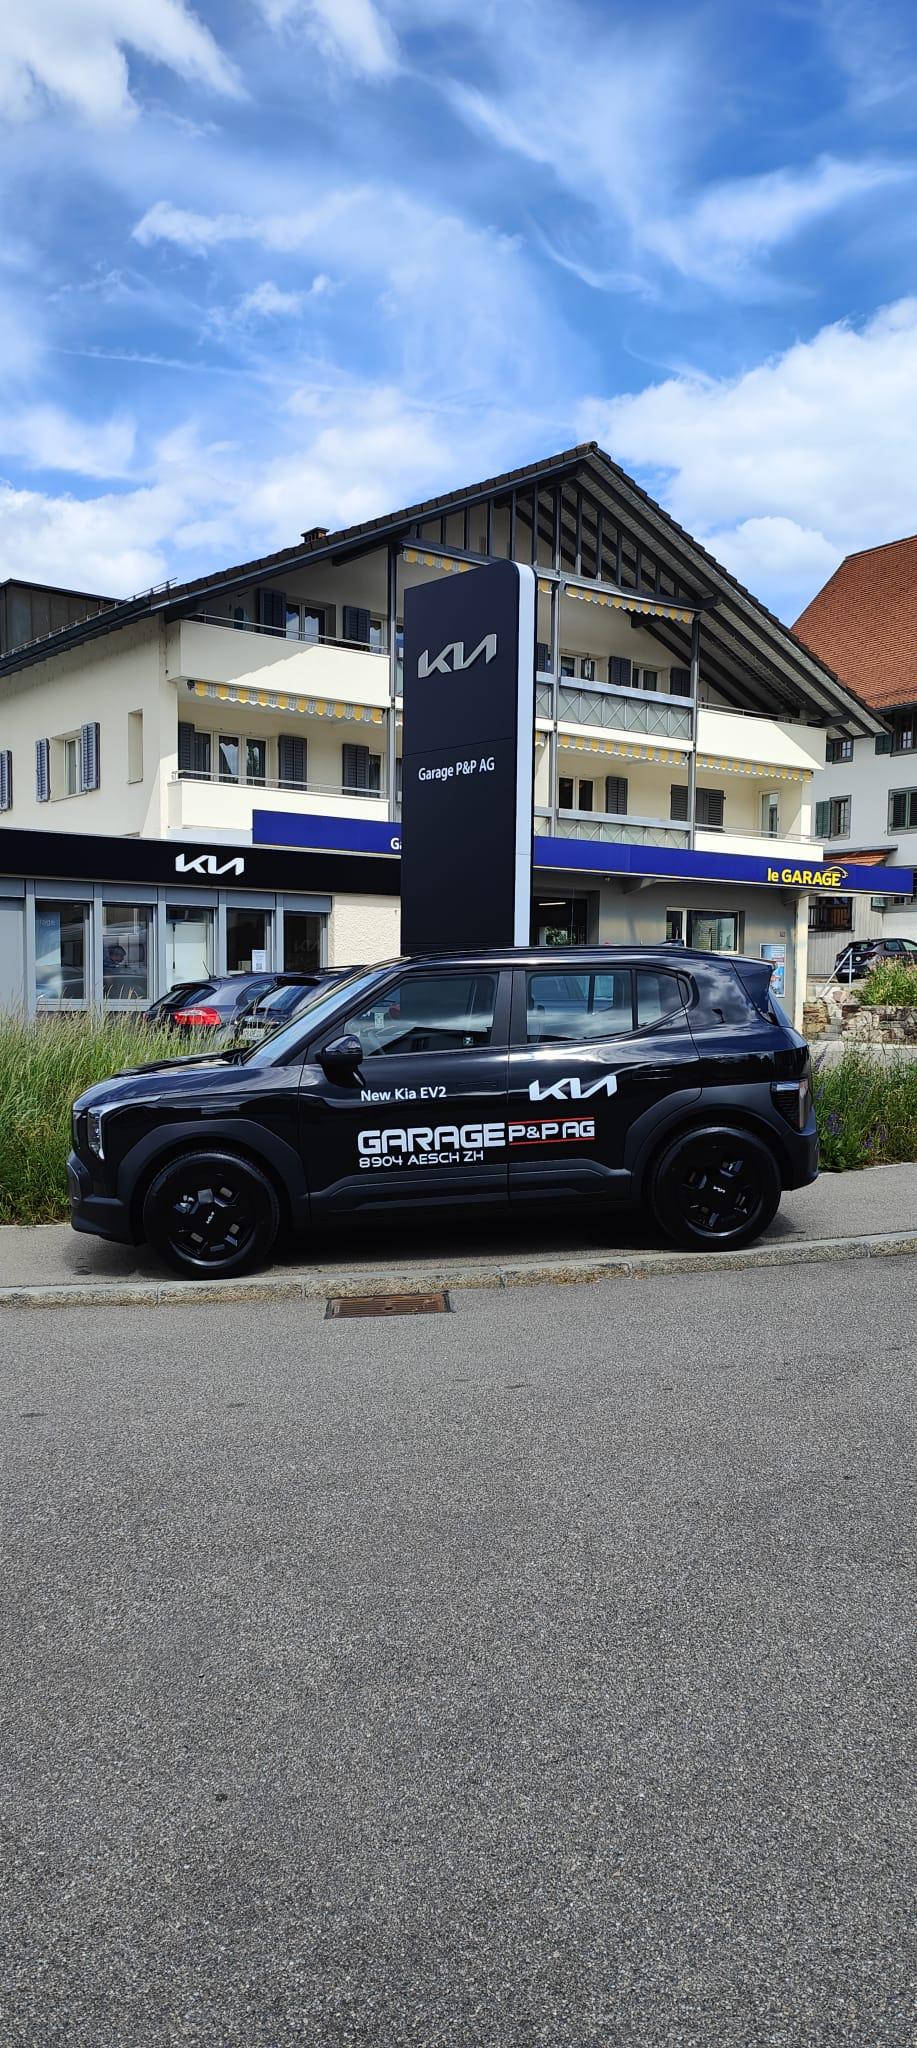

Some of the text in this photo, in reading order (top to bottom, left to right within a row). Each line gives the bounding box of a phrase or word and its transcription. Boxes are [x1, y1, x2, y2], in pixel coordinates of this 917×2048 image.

[417, 633, 498, 679] KIA
[418, 756, 495, 781] Garage P&P AG
[390, 837, 402, 850] G
[175, 853, 245, 876] KIA
[767, 867, 841, 887] le GARAGE
[360, 1086, 447, 1102] New Kia EV2
[528, 1075, 618, 1101] KIA
[357, 1120, 595, 1155] GARAGE P&P AG
[358, 1150, 484, 1169] 8904 AESCH ZH
